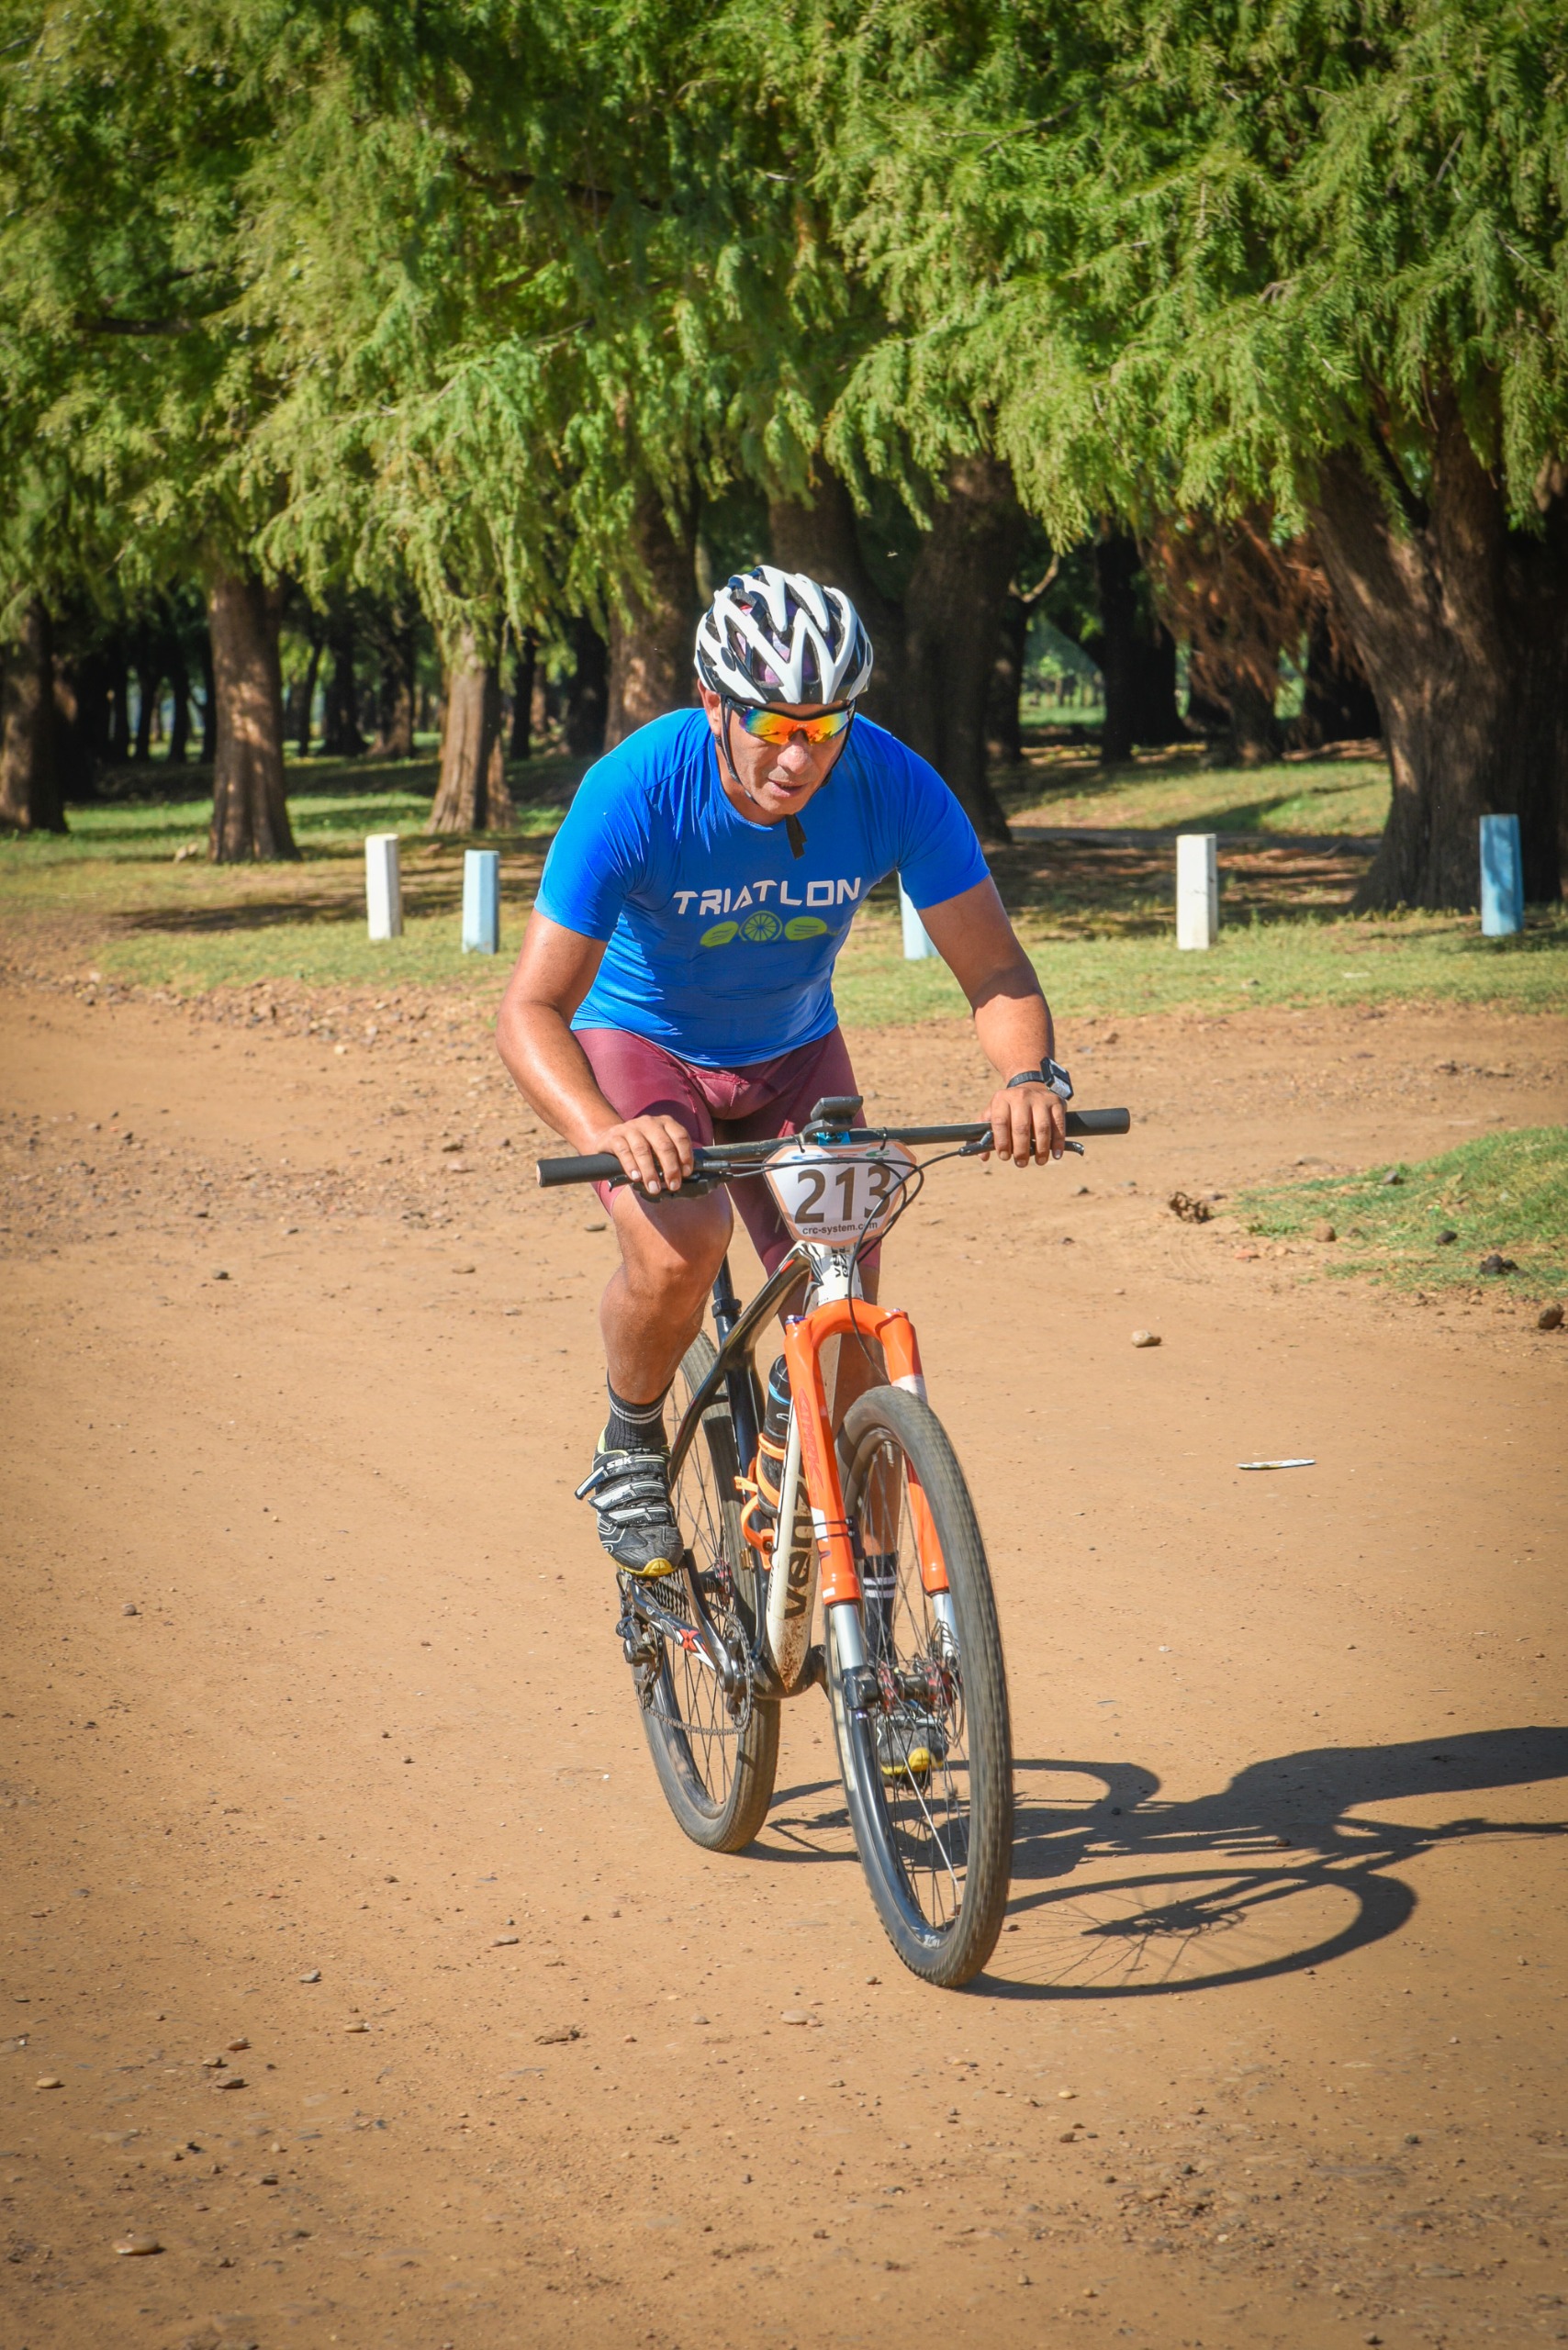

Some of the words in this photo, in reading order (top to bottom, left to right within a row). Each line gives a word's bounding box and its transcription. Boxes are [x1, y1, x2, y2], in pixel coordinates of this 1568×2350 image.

[673, 877, 861, 916] TRIATLON
[794, 1164, 891, 1225] 213
[802, 1221, 878, 1236] crc-system.cm
